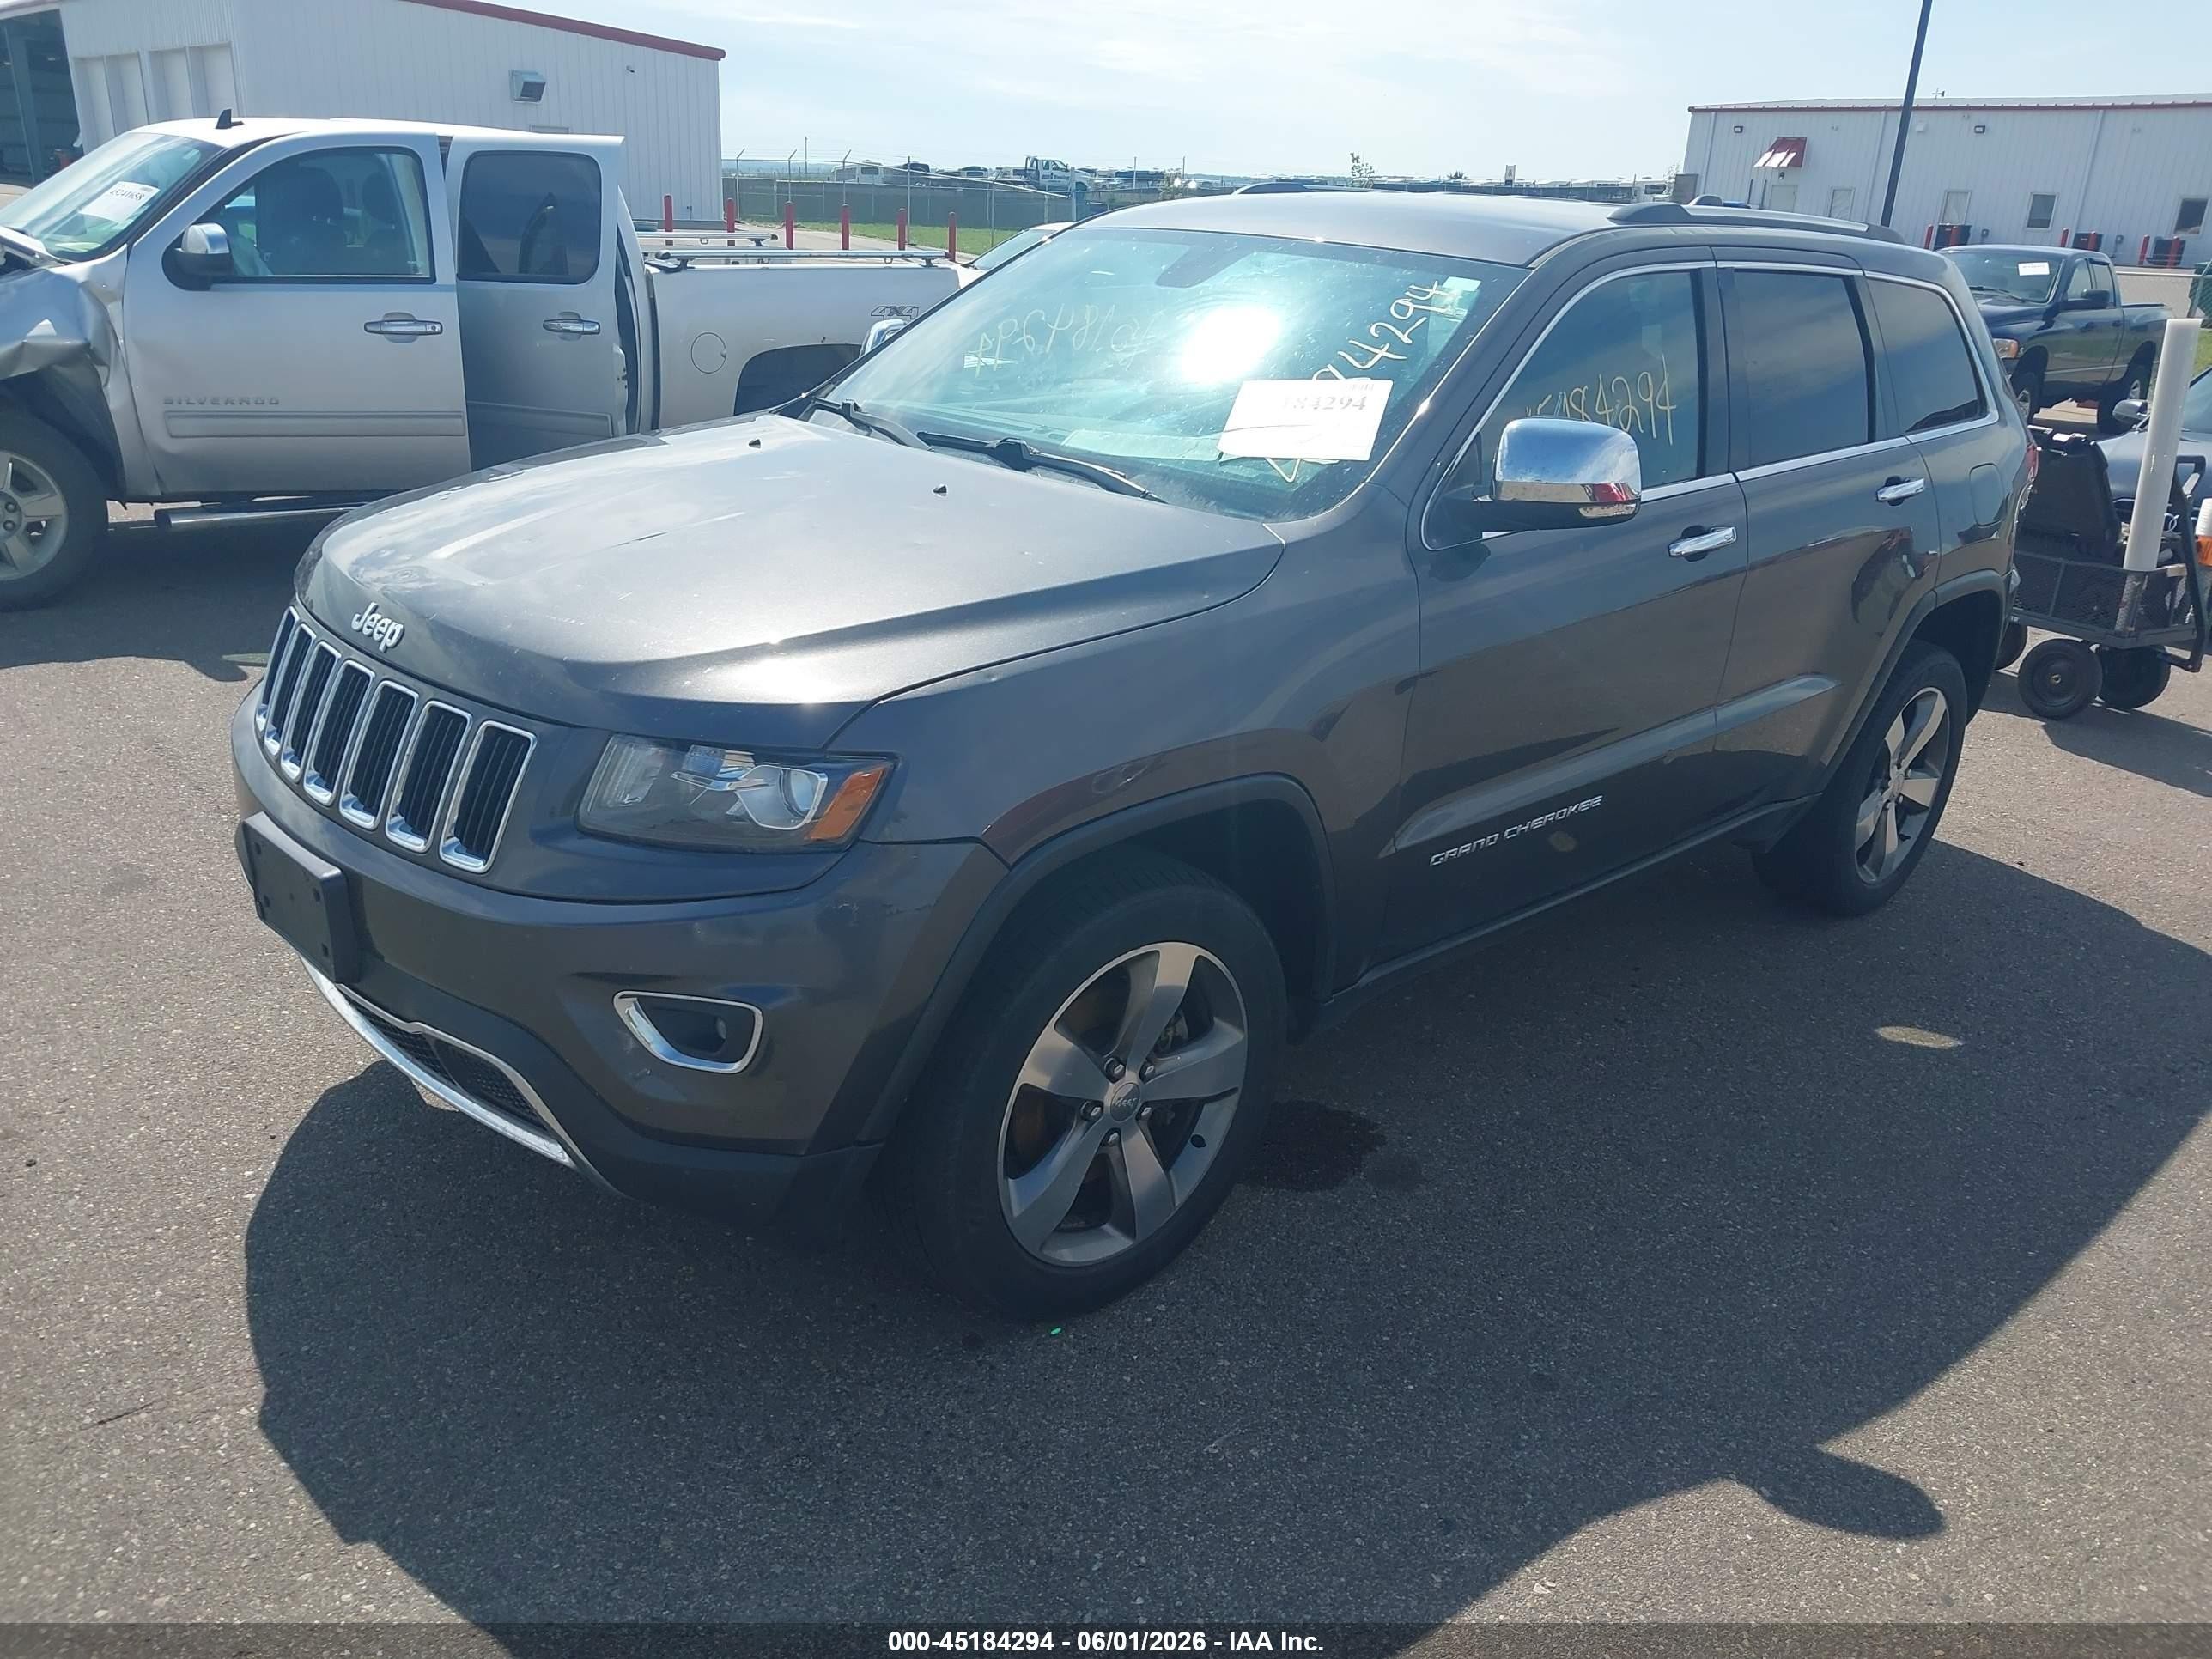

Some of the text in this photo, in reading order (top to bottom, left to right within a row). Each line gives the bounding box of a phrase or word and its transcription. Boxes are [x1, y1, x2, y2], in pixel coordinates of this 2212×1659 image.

[163, 396, 280, 405] SILVERADO
[1526, 354, 1676, 446] 184294
[350, 601, 405, 653] Jeep
[1430, 795, 1603, 866] GRAND CHEROKEE
